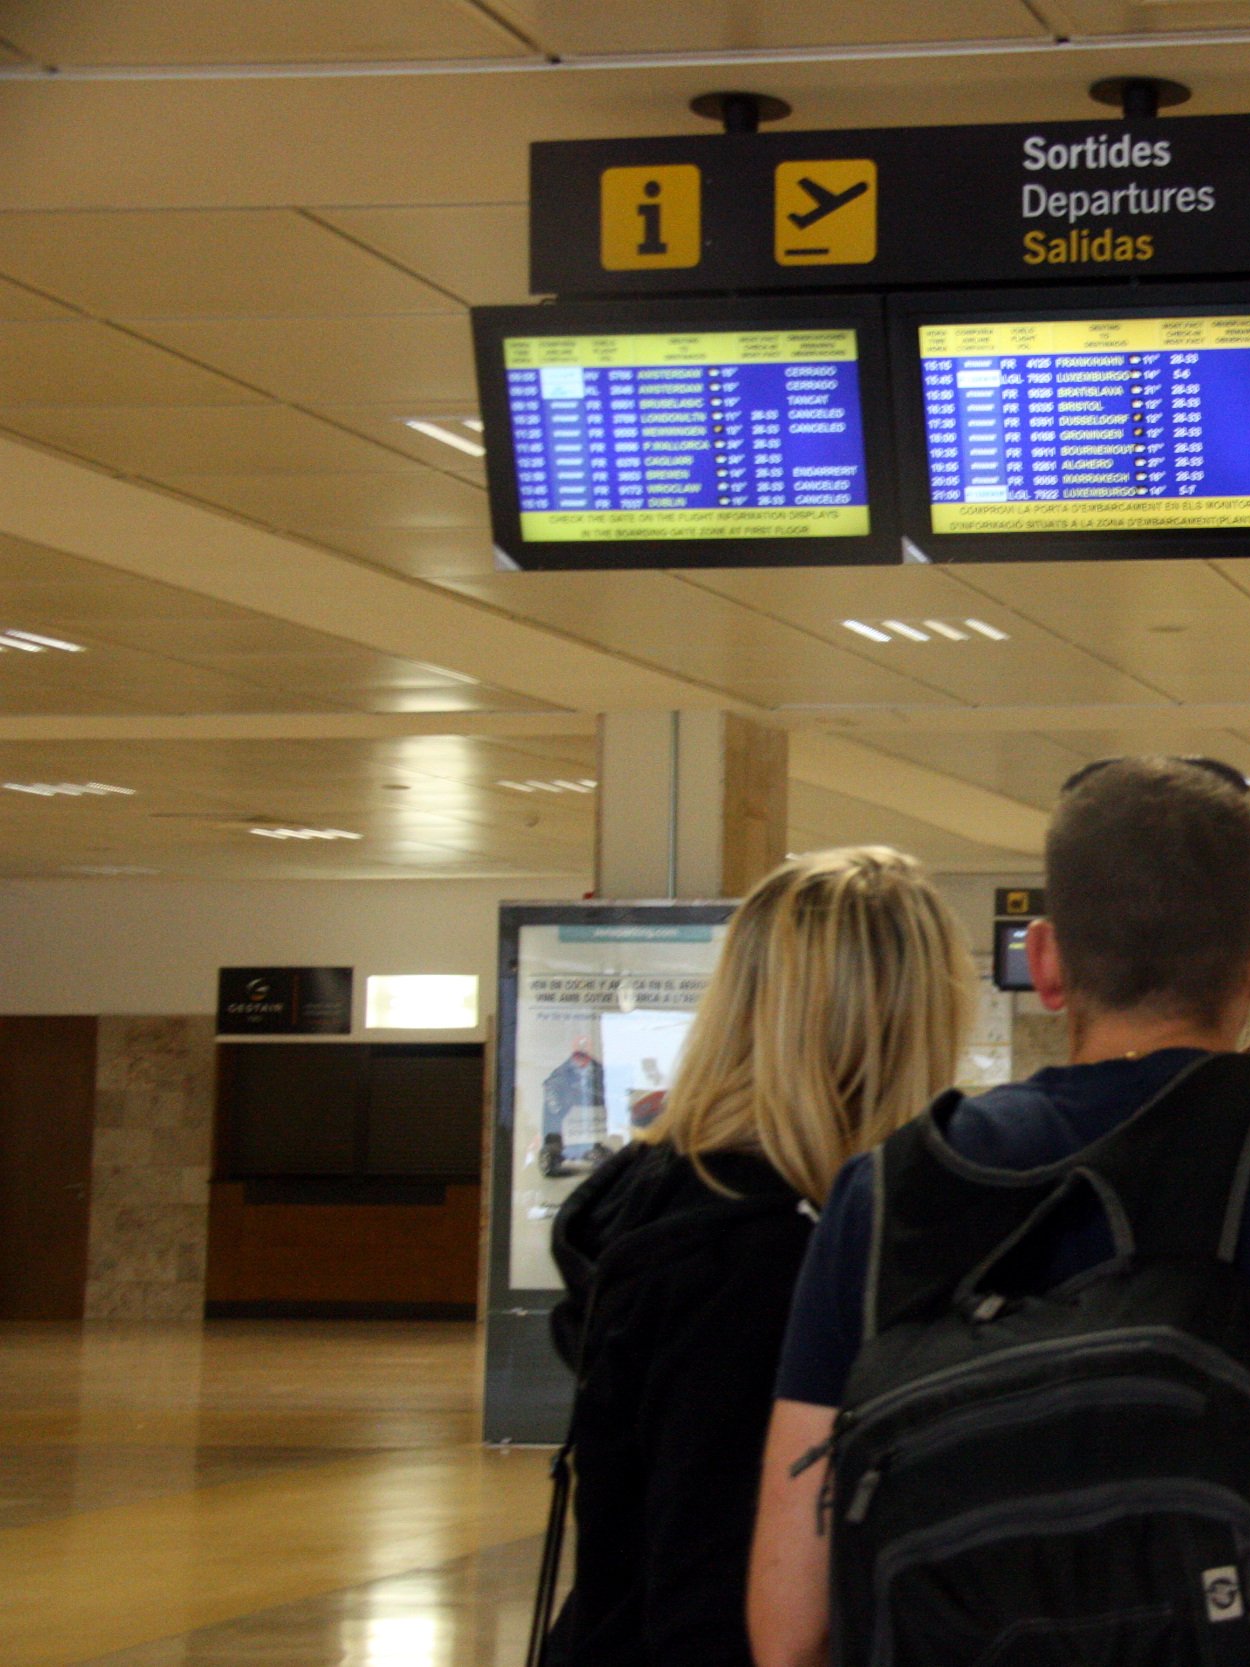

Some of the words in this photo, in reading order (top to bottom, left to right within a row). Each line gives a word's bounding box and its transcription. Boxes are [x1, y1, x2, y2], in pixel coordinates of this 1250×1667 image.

[1022, 134, 1171, 170] Sortides
[1022, 182, 1215, 224] Departures
[1023, 228, 1154, 264] Salidas
[1001, 359, 1016, 370] FR
[784, 366, 837, 377] CERRADO
[1002, 374, 1024, 384] LGL
[785, 380, 838, 391] CERRADO
[1003, 388, 1018, 398] FR
[1057, 386, 1124, 397] BRATISLAVA
[1004, 402, 1019, 413] FR
[1058, 400, 1104, 412] BRISTOL
[788, 408, 845, 418] CANCELED
[1005, 416, 1020, 427] FR
[1059, 414, 1130, 426] DUSSELDORF
[789, 422, 846, 433] CANCELED
[1006, 432, 1021, 442] FR
[1006, 447, 1022, 458] FR
[1007, 461, 1022, 472] FR
[793, 480, 850, 490] CANCELED
[1008, 476, 1023, 486] FR
[794, 494, 851, 504] CANCELED
[1009, 490, 1031, 500] LGL
[1019, 505, 1030, 514] LA
[1034, 505, 1067, 514] PORTA
